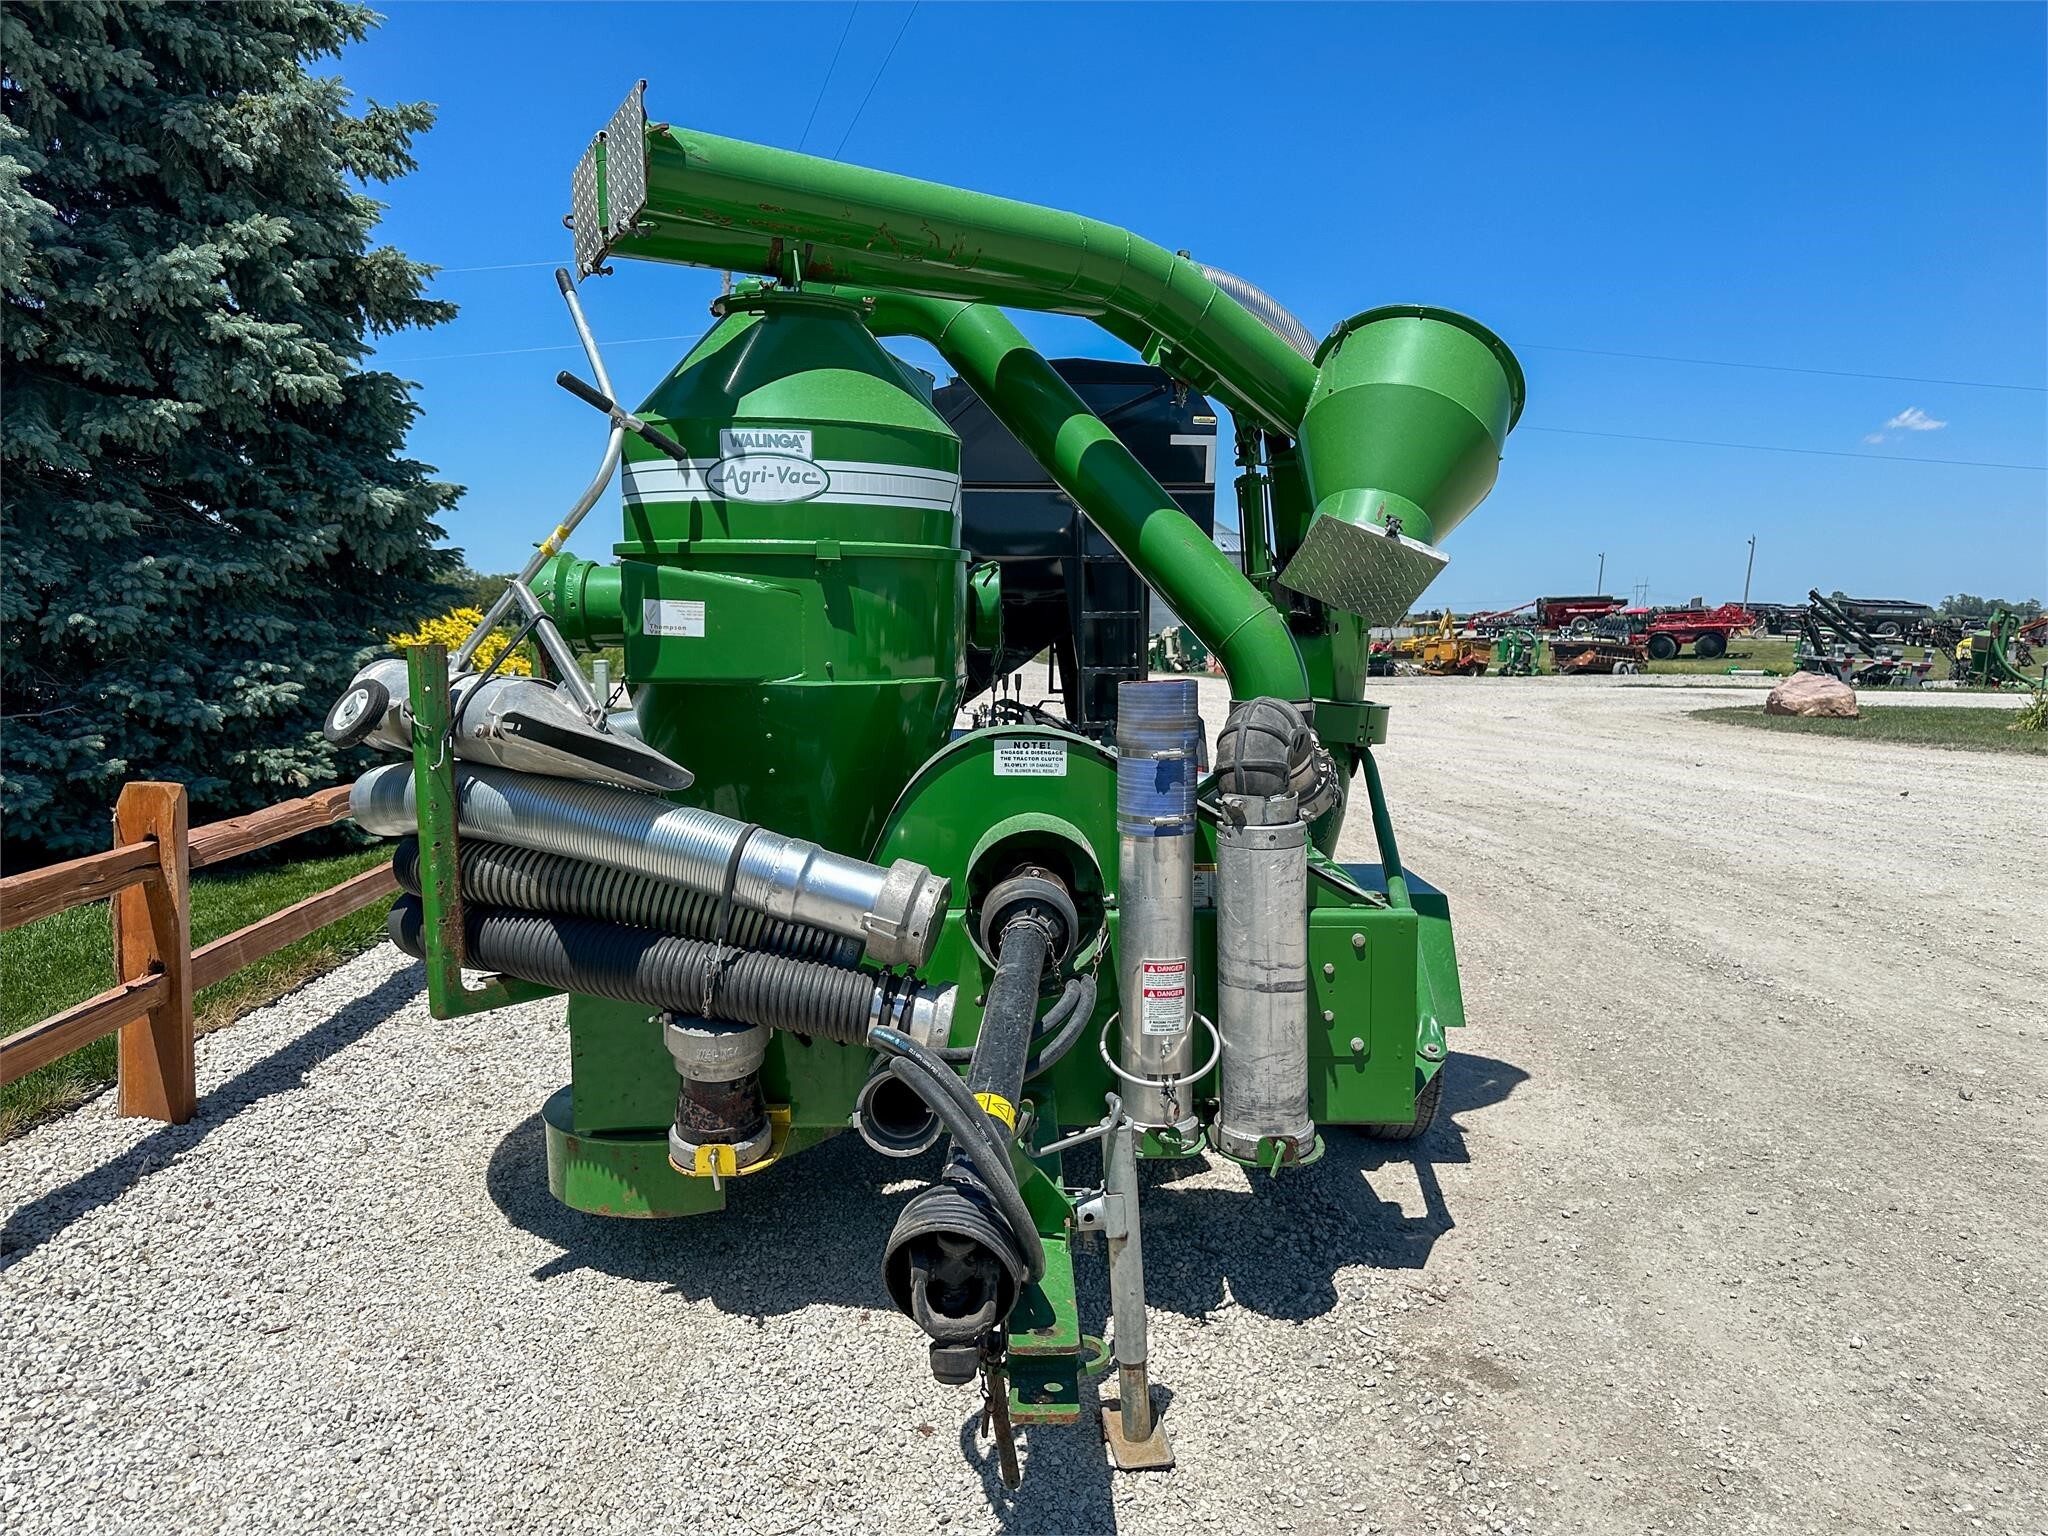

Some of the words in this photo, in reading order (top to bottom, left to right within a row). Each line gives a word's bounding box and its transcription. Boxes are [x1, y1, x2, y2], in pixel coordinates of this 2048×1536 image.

[729, 433, 804, 448] WALINGA
[713, 465, 821, 495] Agri-Vac
[1013, 741, 1051, 749] NOTE!
[1157, 964, 1183, 972] DANGER
